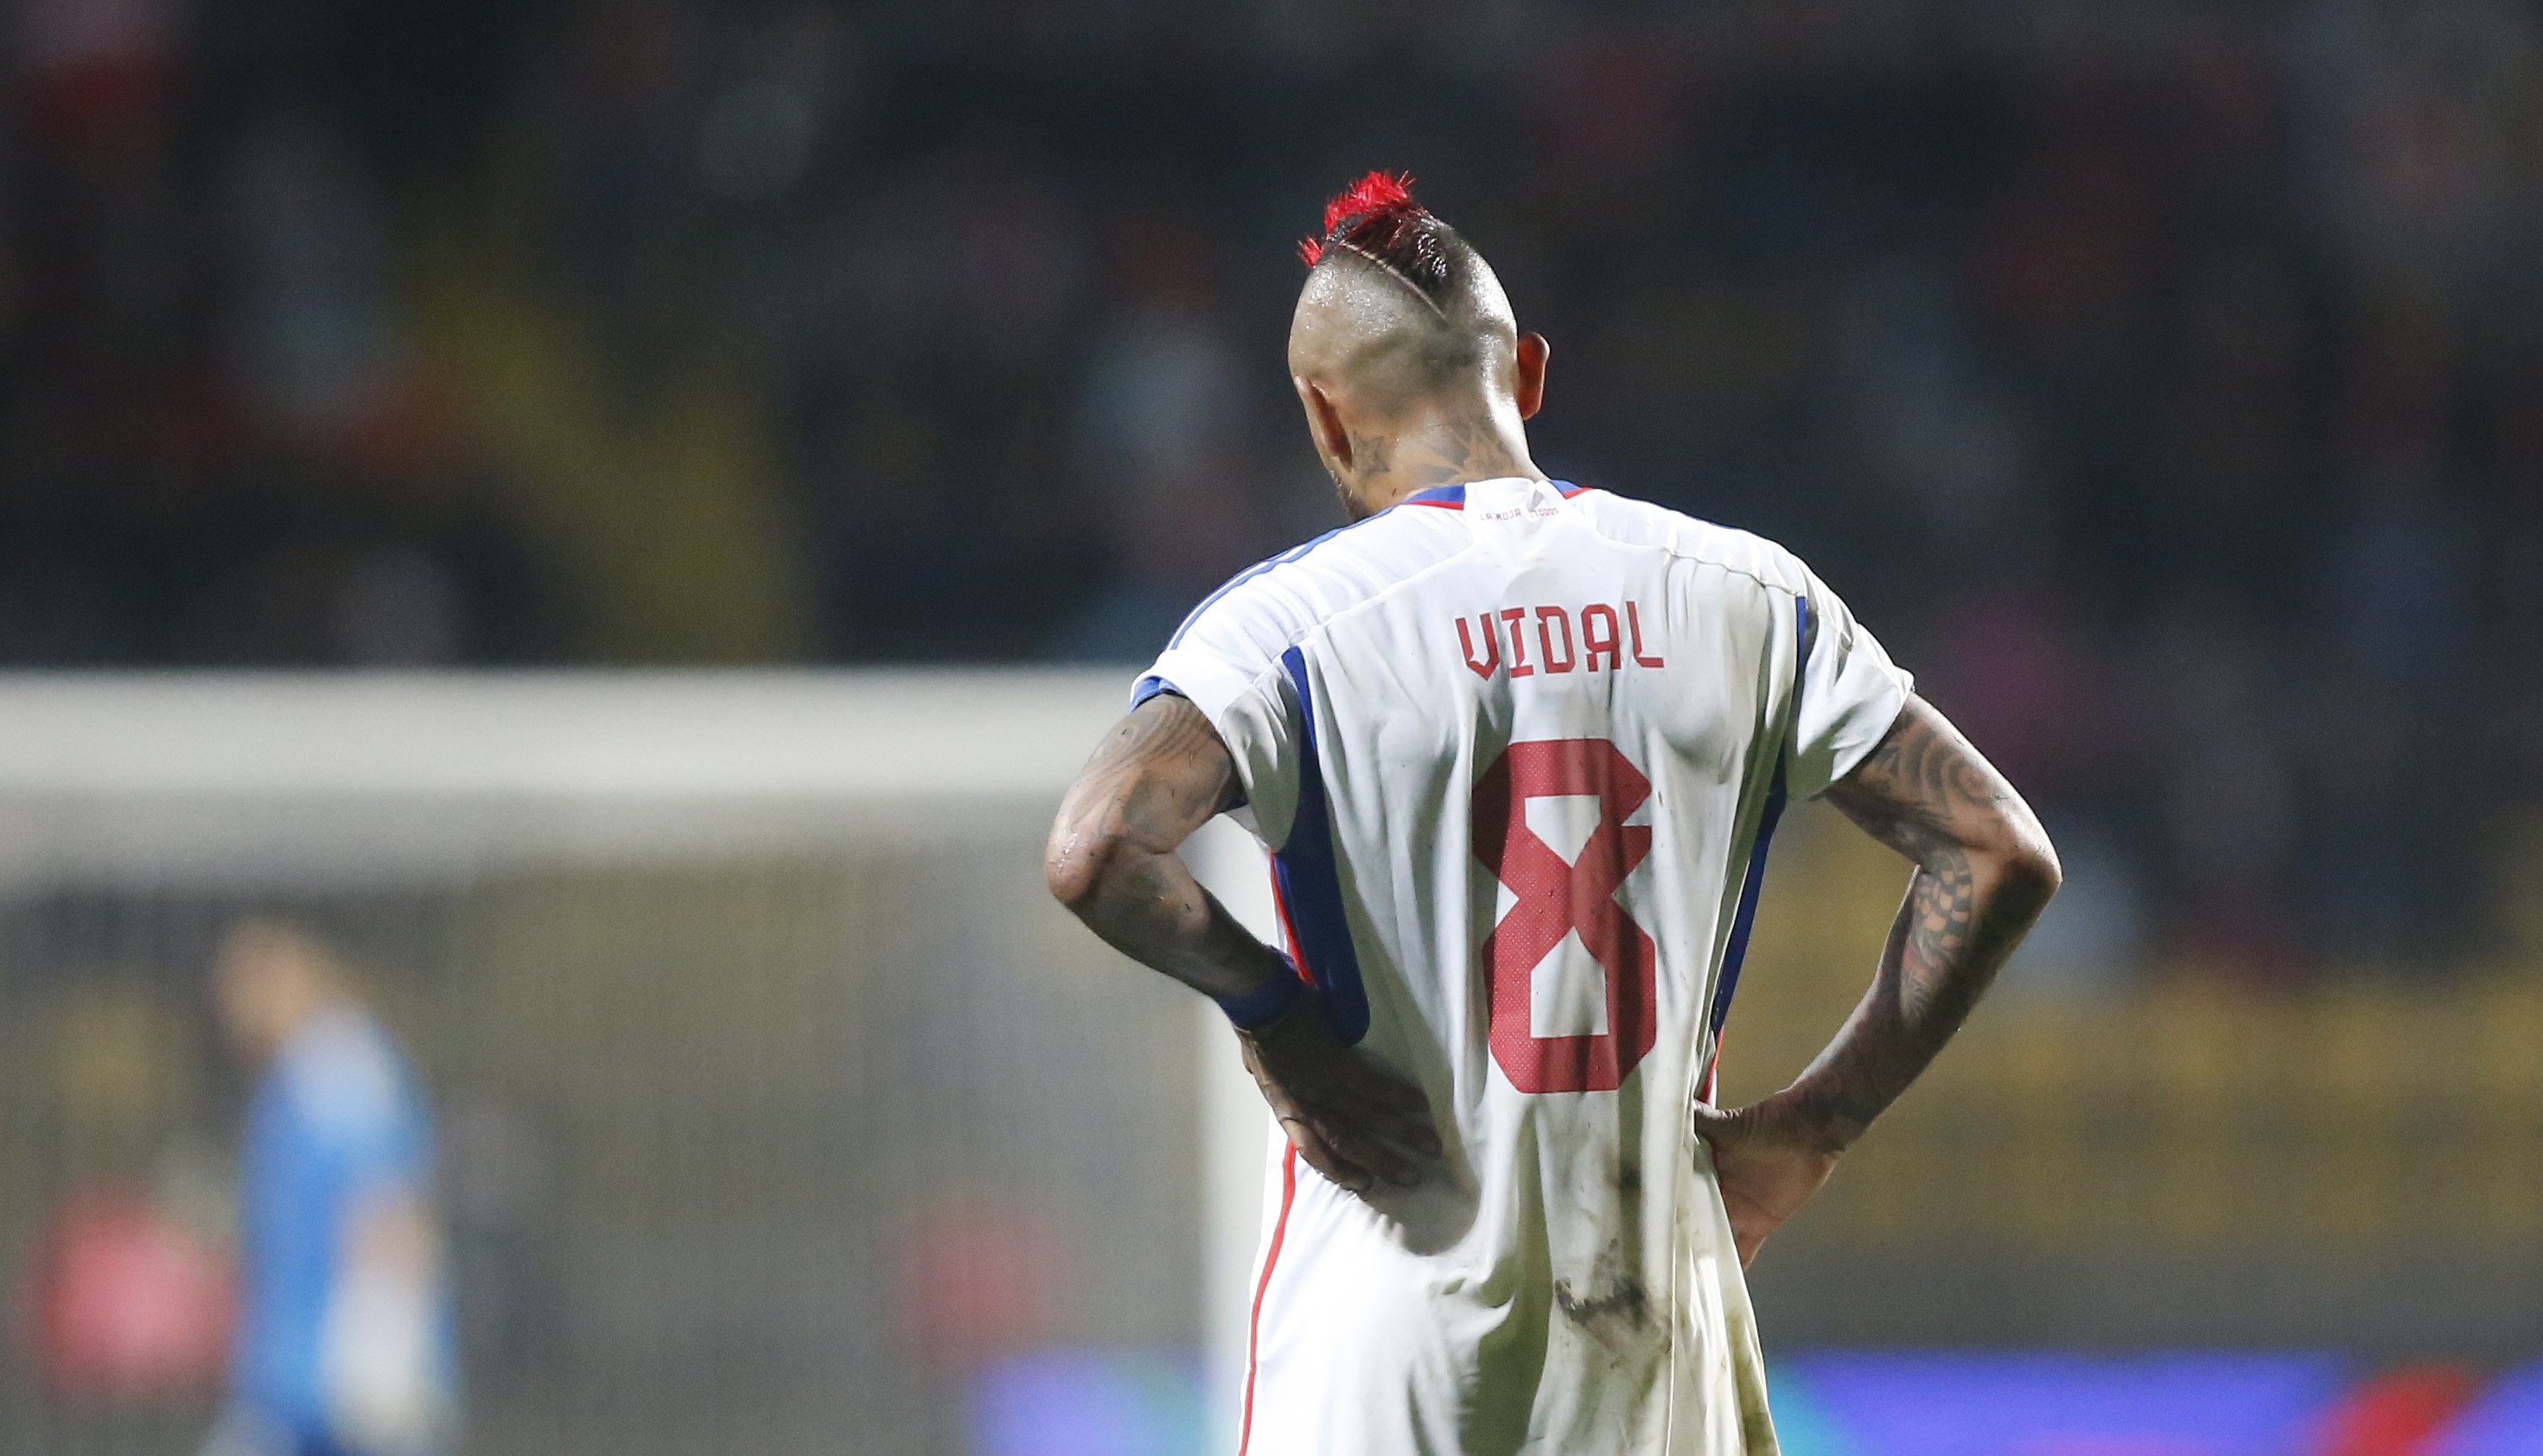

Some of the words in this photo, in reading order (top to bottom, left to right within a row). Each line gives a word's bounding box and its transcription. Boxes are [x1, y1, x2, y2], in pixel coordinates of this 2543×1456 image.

[1480, 512, 1494, 521] LA
[1495, 508, 1522, 521] ROJA
[1455, 601, 1664, 681] VIDAL
[1471, 739, 1657, 1093] 8
